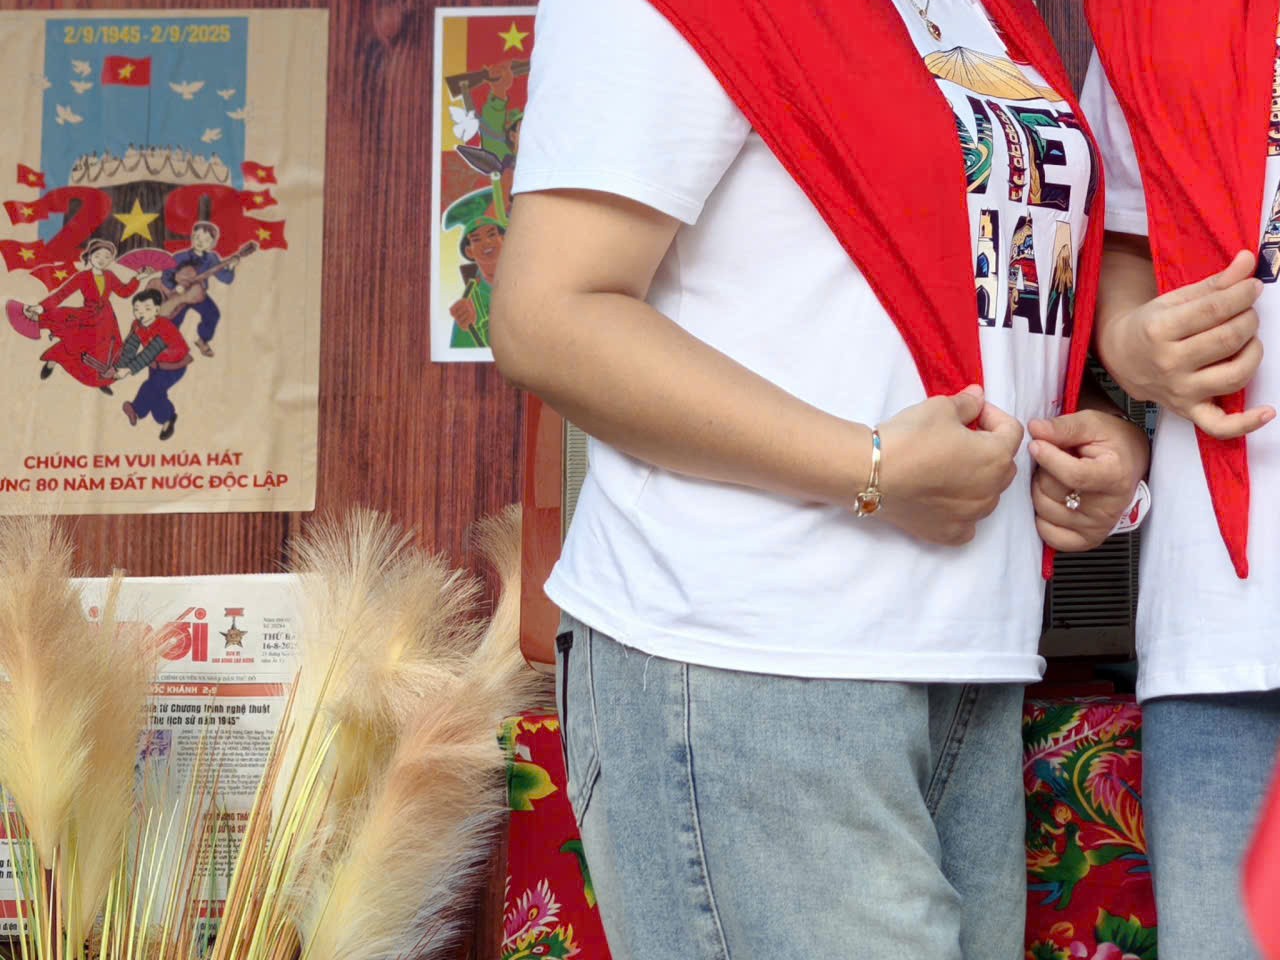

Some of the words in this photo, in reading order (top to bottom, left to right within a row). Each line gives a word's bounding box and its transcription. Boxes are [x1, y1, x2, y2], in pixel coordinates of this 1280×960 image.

[24, 452, 88, 470] CHÚNG
[93, 454, 119, 469] EM
[124, 453, 155, 468] VUI
[160, 450, 202, 467] MÚA
[206, 449, 243, 466] HÁT
[36, 477, 58, 491] 80
[63, 474, 105, 491] NĂM
[109, 471, 147, 491] ĐẤT
[151, 472, 204, 490] NƯỚC
[208, 471, 248, 492] ĐỘC
[253, 470, 289, 492] LẬP
[167, 683, 198, 694] KHÁNH
